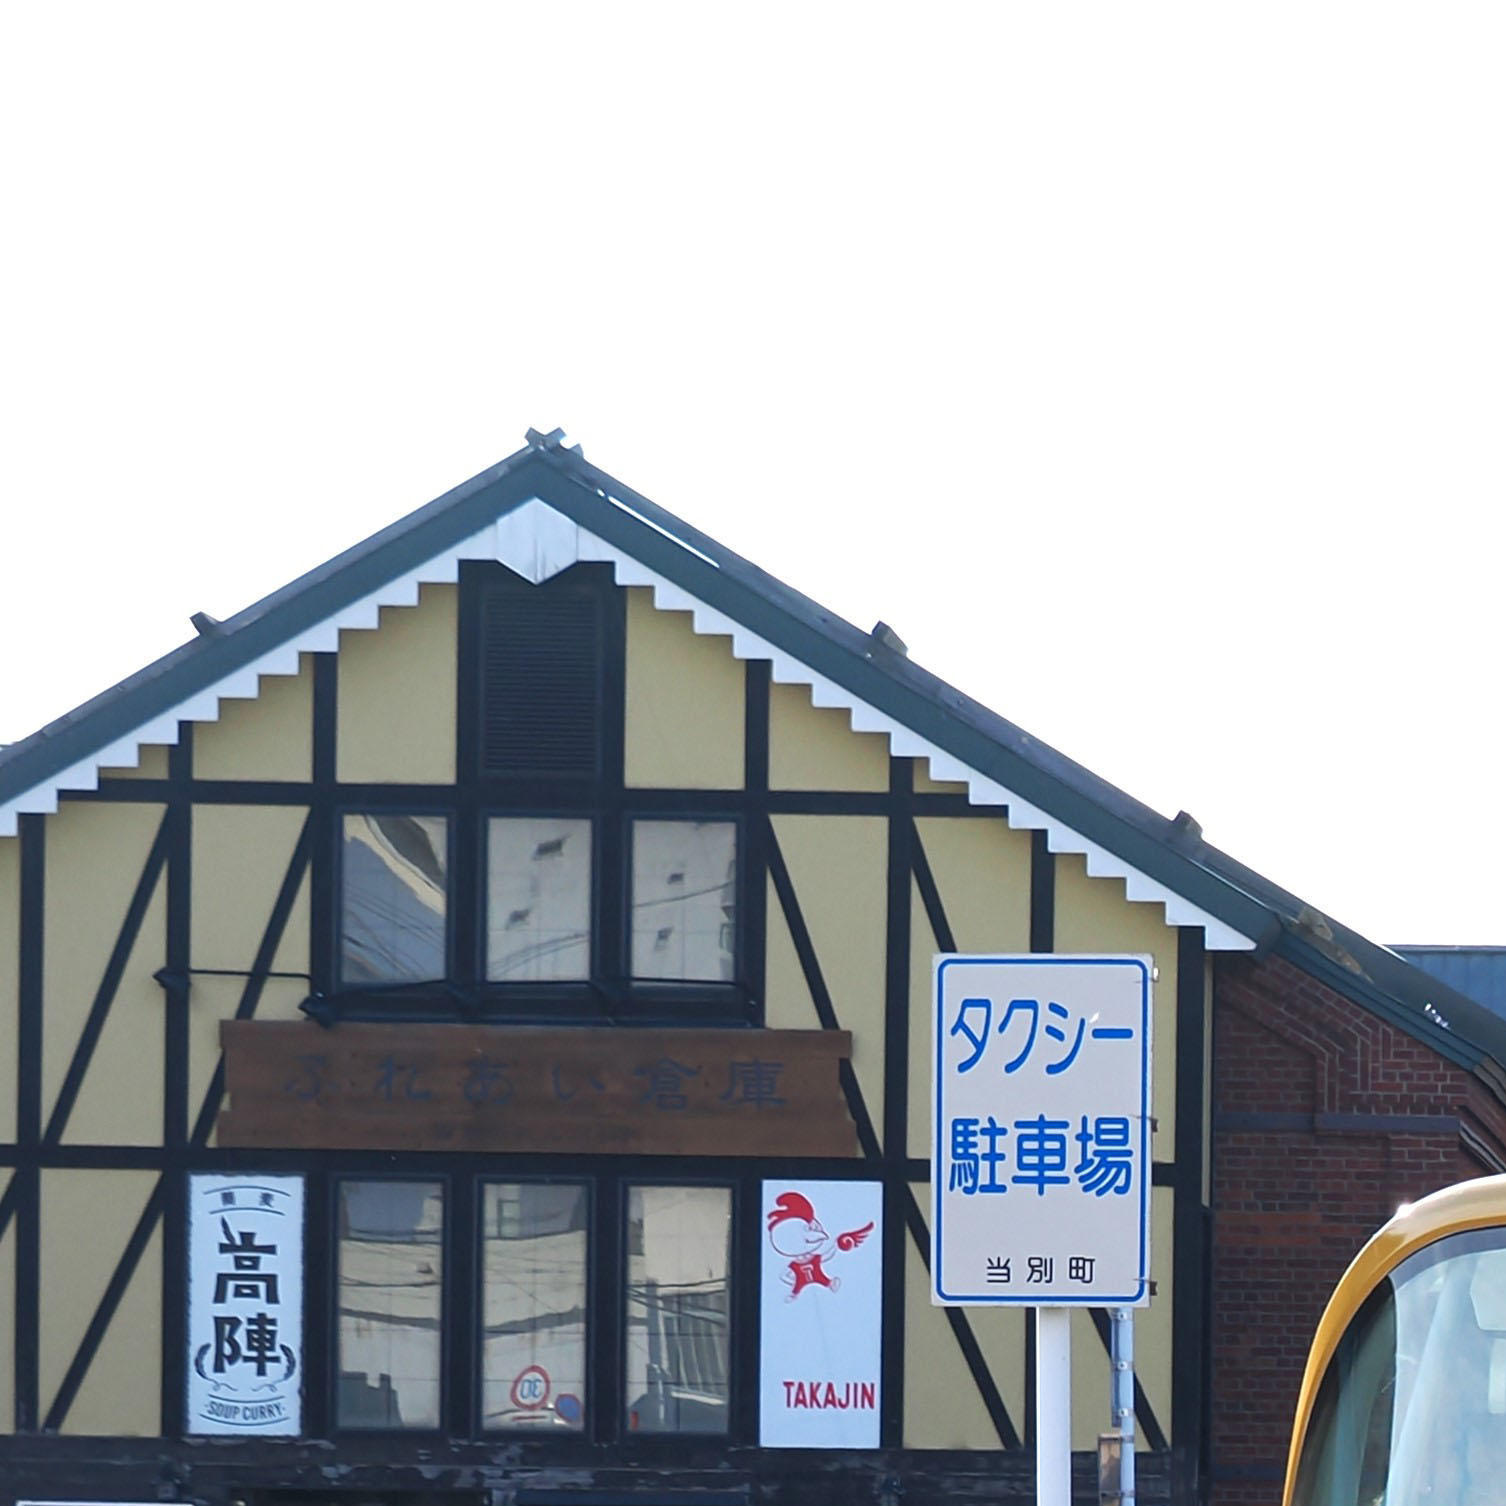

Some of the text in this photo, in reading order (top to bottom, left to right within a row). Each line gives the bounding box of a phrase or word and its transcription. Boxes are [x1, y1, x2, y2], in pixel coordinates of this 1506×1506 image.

[950, 998, 1134, 1075] タクシー
[283, 1055, 788, 1112] ふれあい倉庫
[949, 1113, 1134, 1197] 駐車場
[986, 1256, 1096, 1284] 当別町
[207, 1402, 283, 1421] SOUP CURRY
[783, 1382, 875, 1410] TAKAJIN
